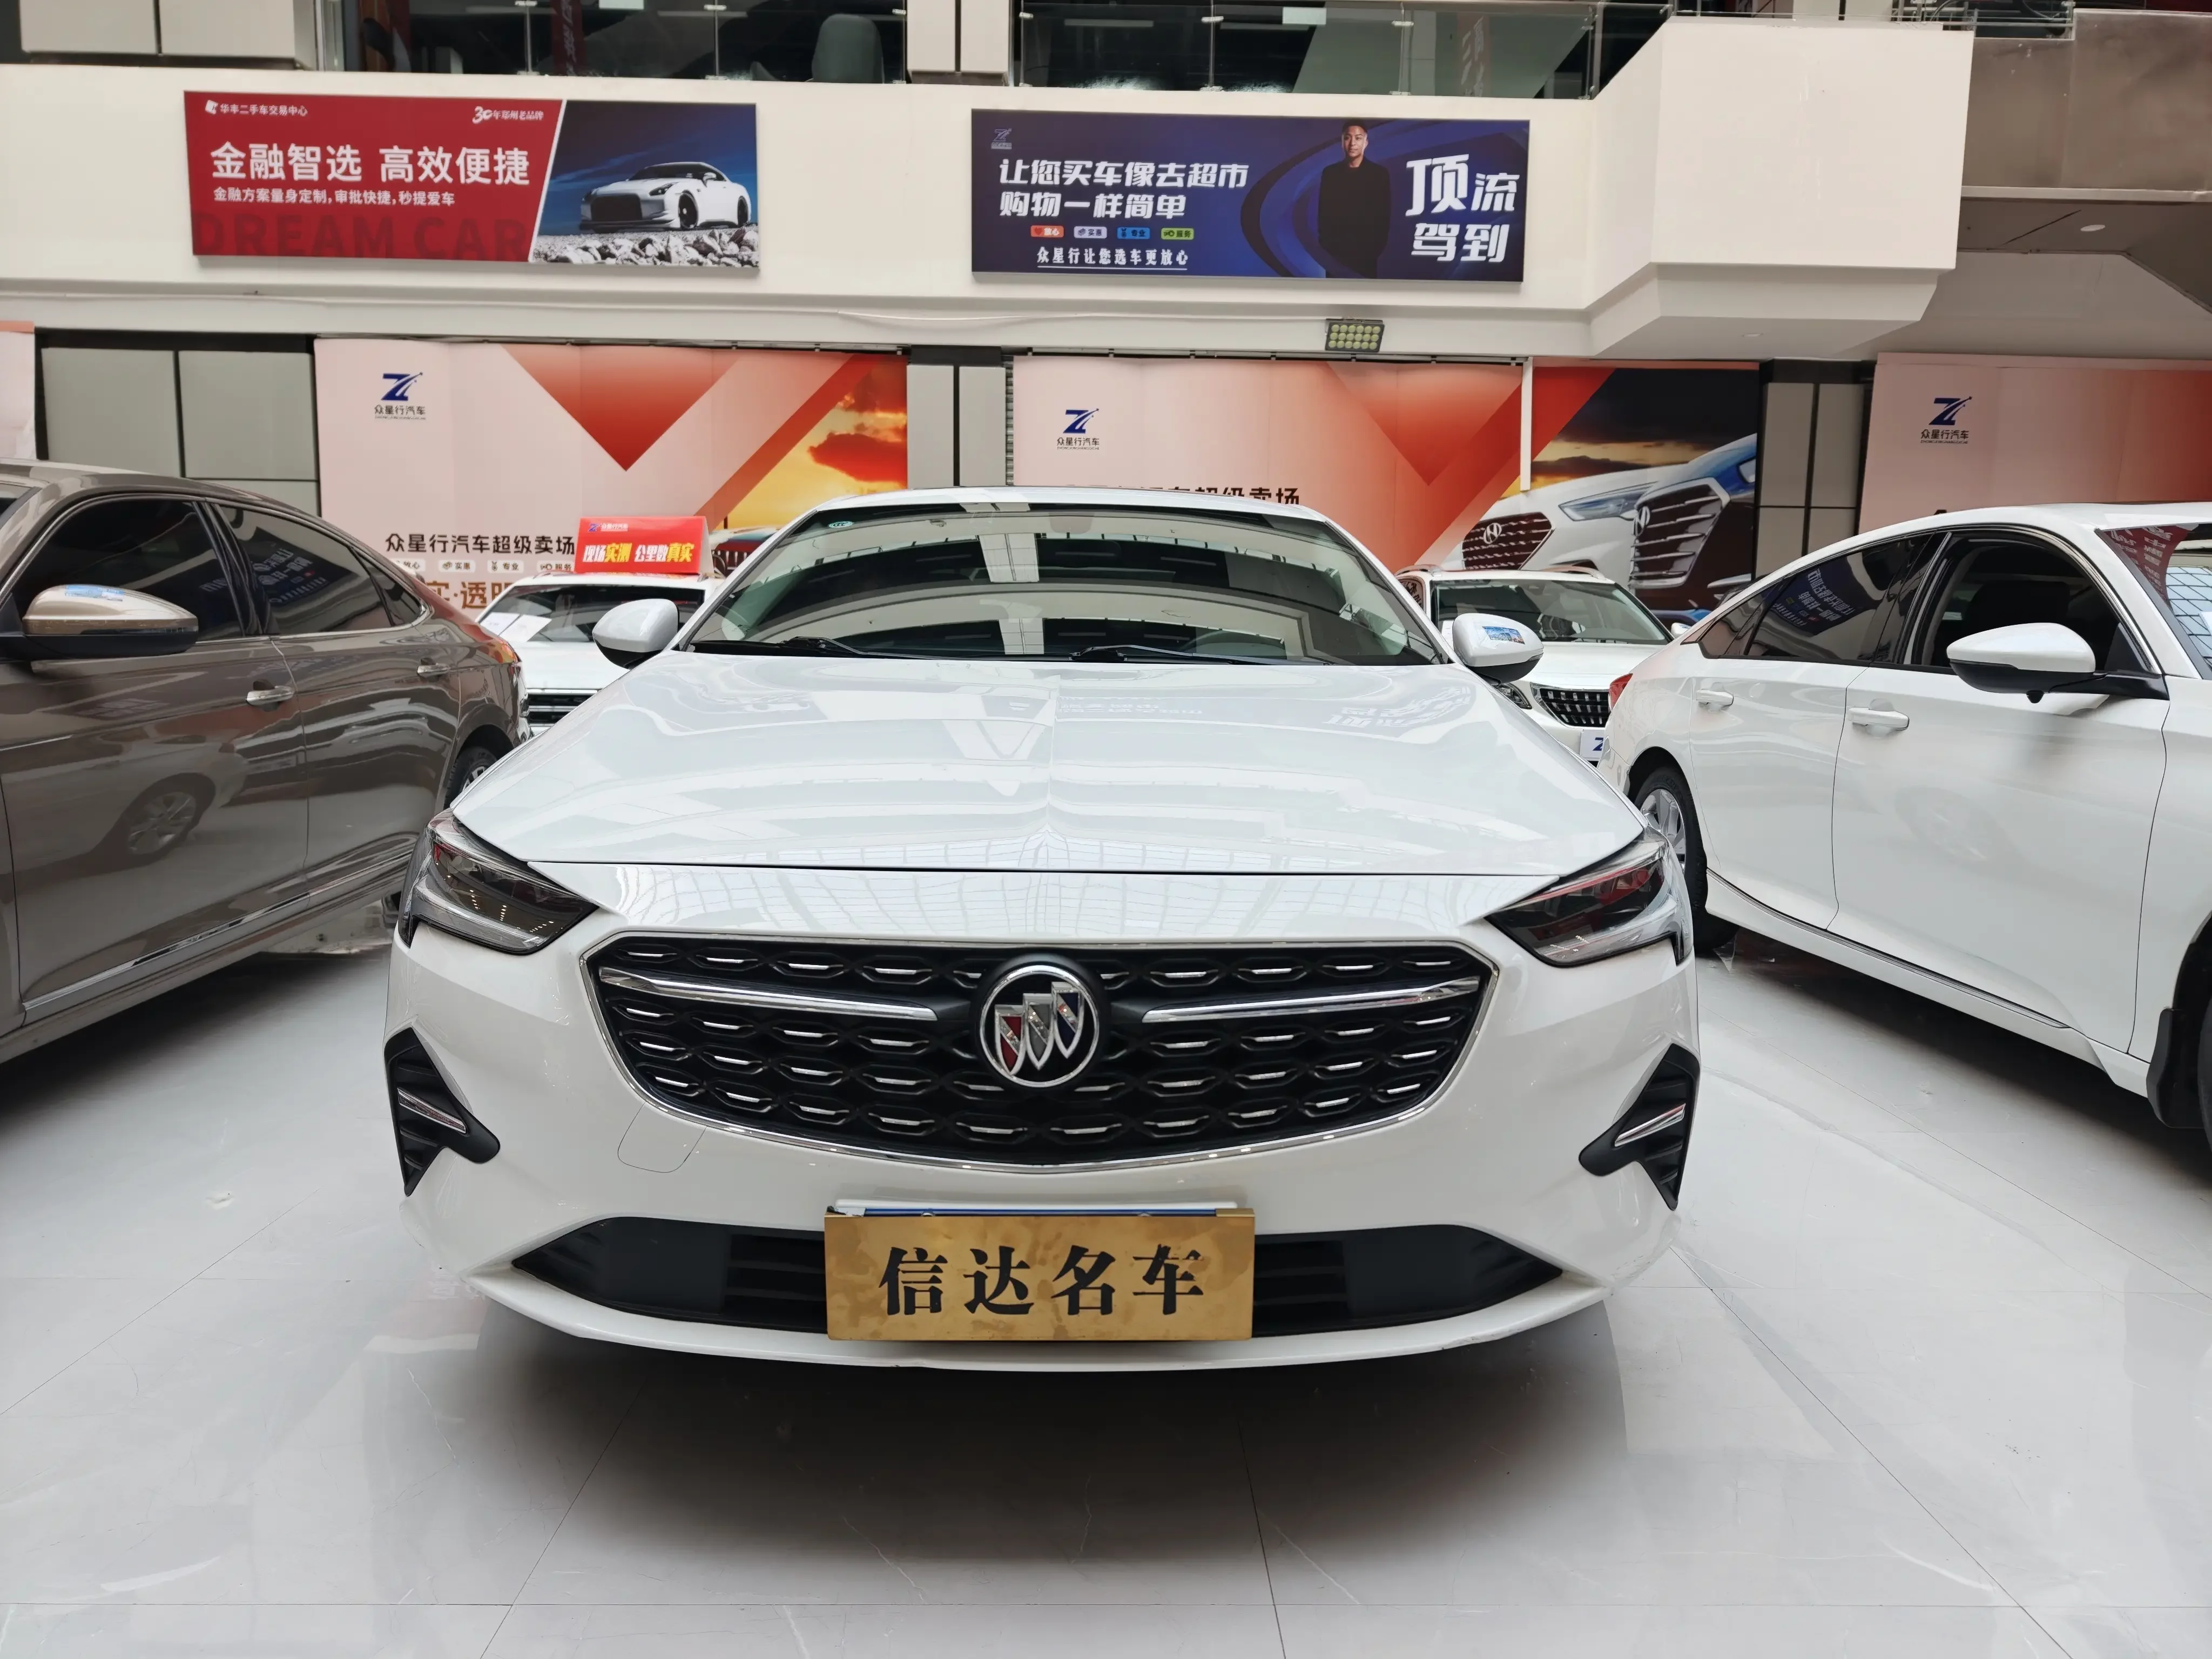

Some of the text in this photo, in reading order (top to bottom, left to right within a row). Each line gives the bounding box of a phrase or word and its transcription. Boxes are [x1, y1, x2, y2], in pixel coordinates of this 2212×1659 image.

[210, 141, 530, 185] 金融智选 高效便捷
[999, 159, 1250, 188] 让您买车像去超市
[1405, 153, 1520, 217] 顶流
[999, 191, 1187, 219] 购物一样简单
[414, 217, 527, 260] CAR
[1411, 222, 1510, 262] 驾到
[1036, 246, 1189, 266] 众星行让您选车更放心
[374, 404, 426, 415] 众星行汽车
[1056, 437, 1100, 446] 众星行汽车
[1920, 429, 1970, 440] 众星行汽车
[385, 533, 576, 555] 众星行汽车超级卖场
[879, 1244, 1204, 1316] 信达名车
